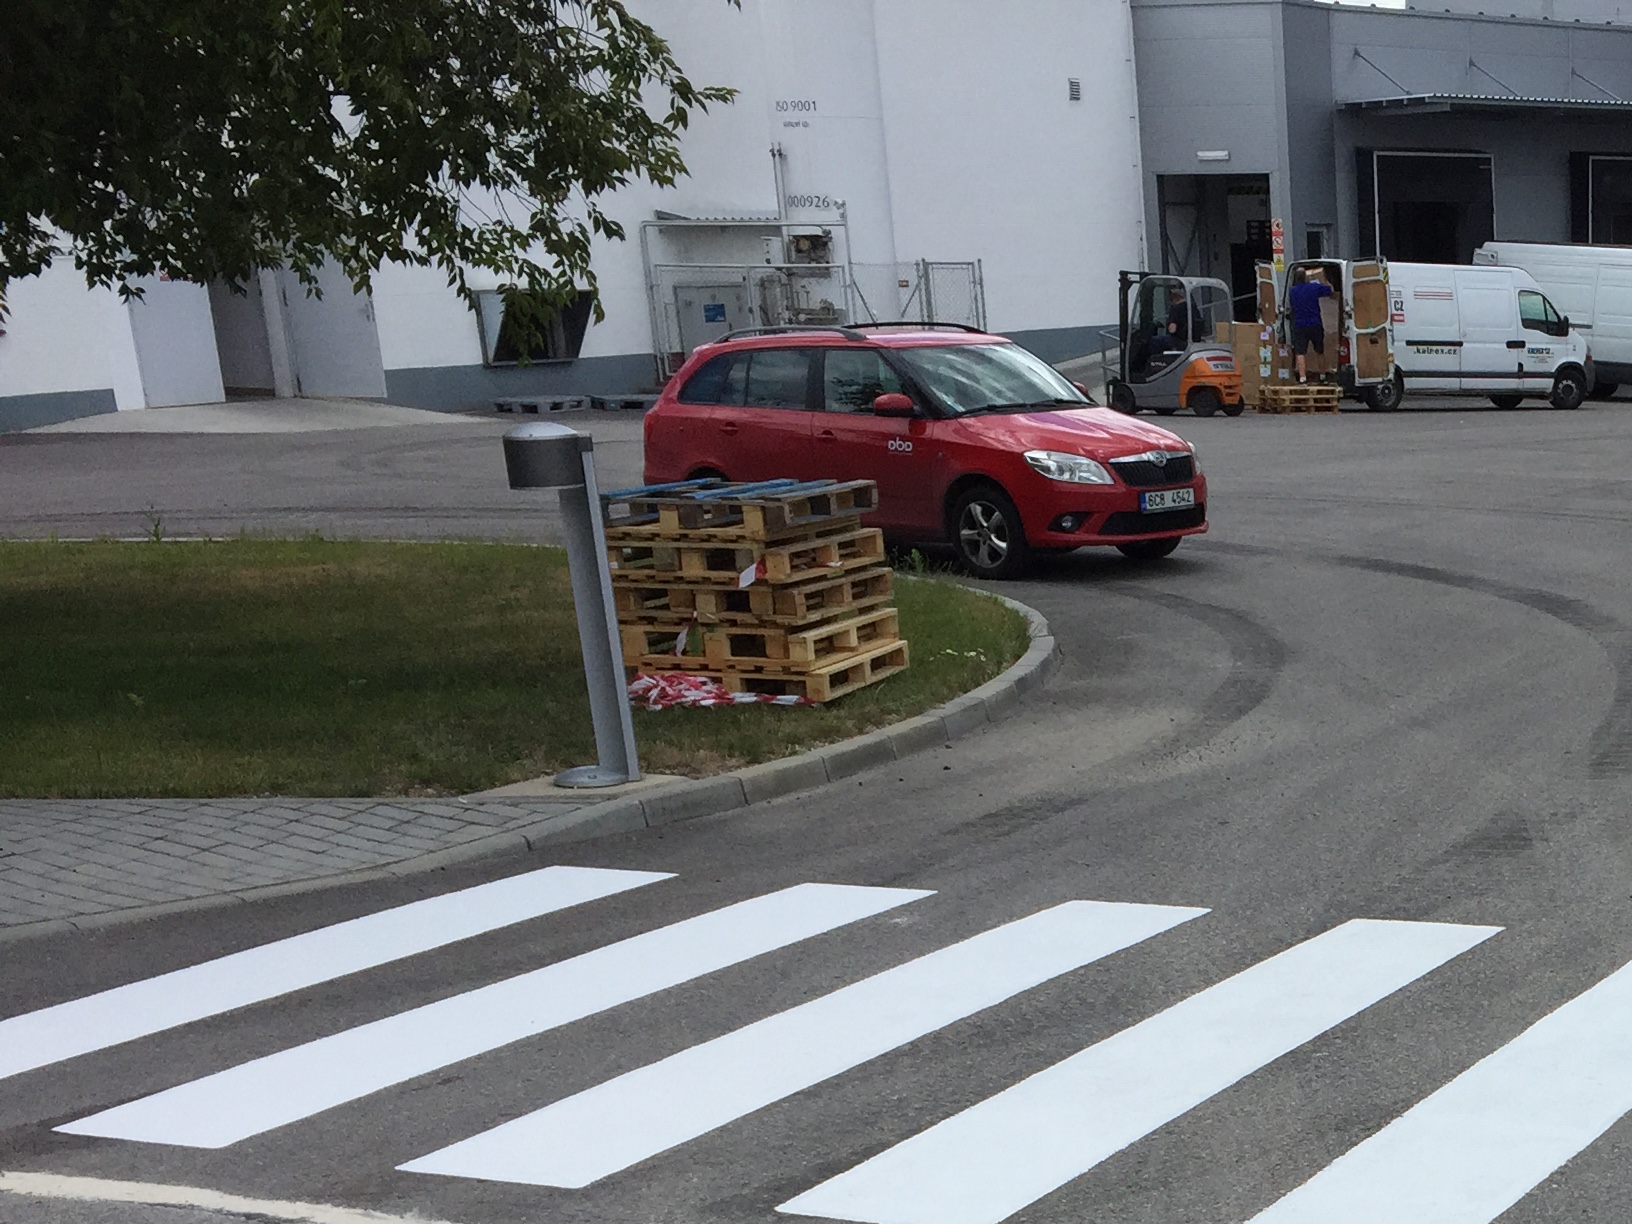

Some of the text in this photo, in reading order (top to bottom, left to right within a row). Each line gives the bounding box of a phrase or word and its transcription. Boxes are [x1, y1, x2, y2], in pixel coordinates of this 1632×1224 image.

[790, 100, 817, 112] 9001
[787, 194, 830, 208] 000926
[1393, 300, 1404, 312] CZ
